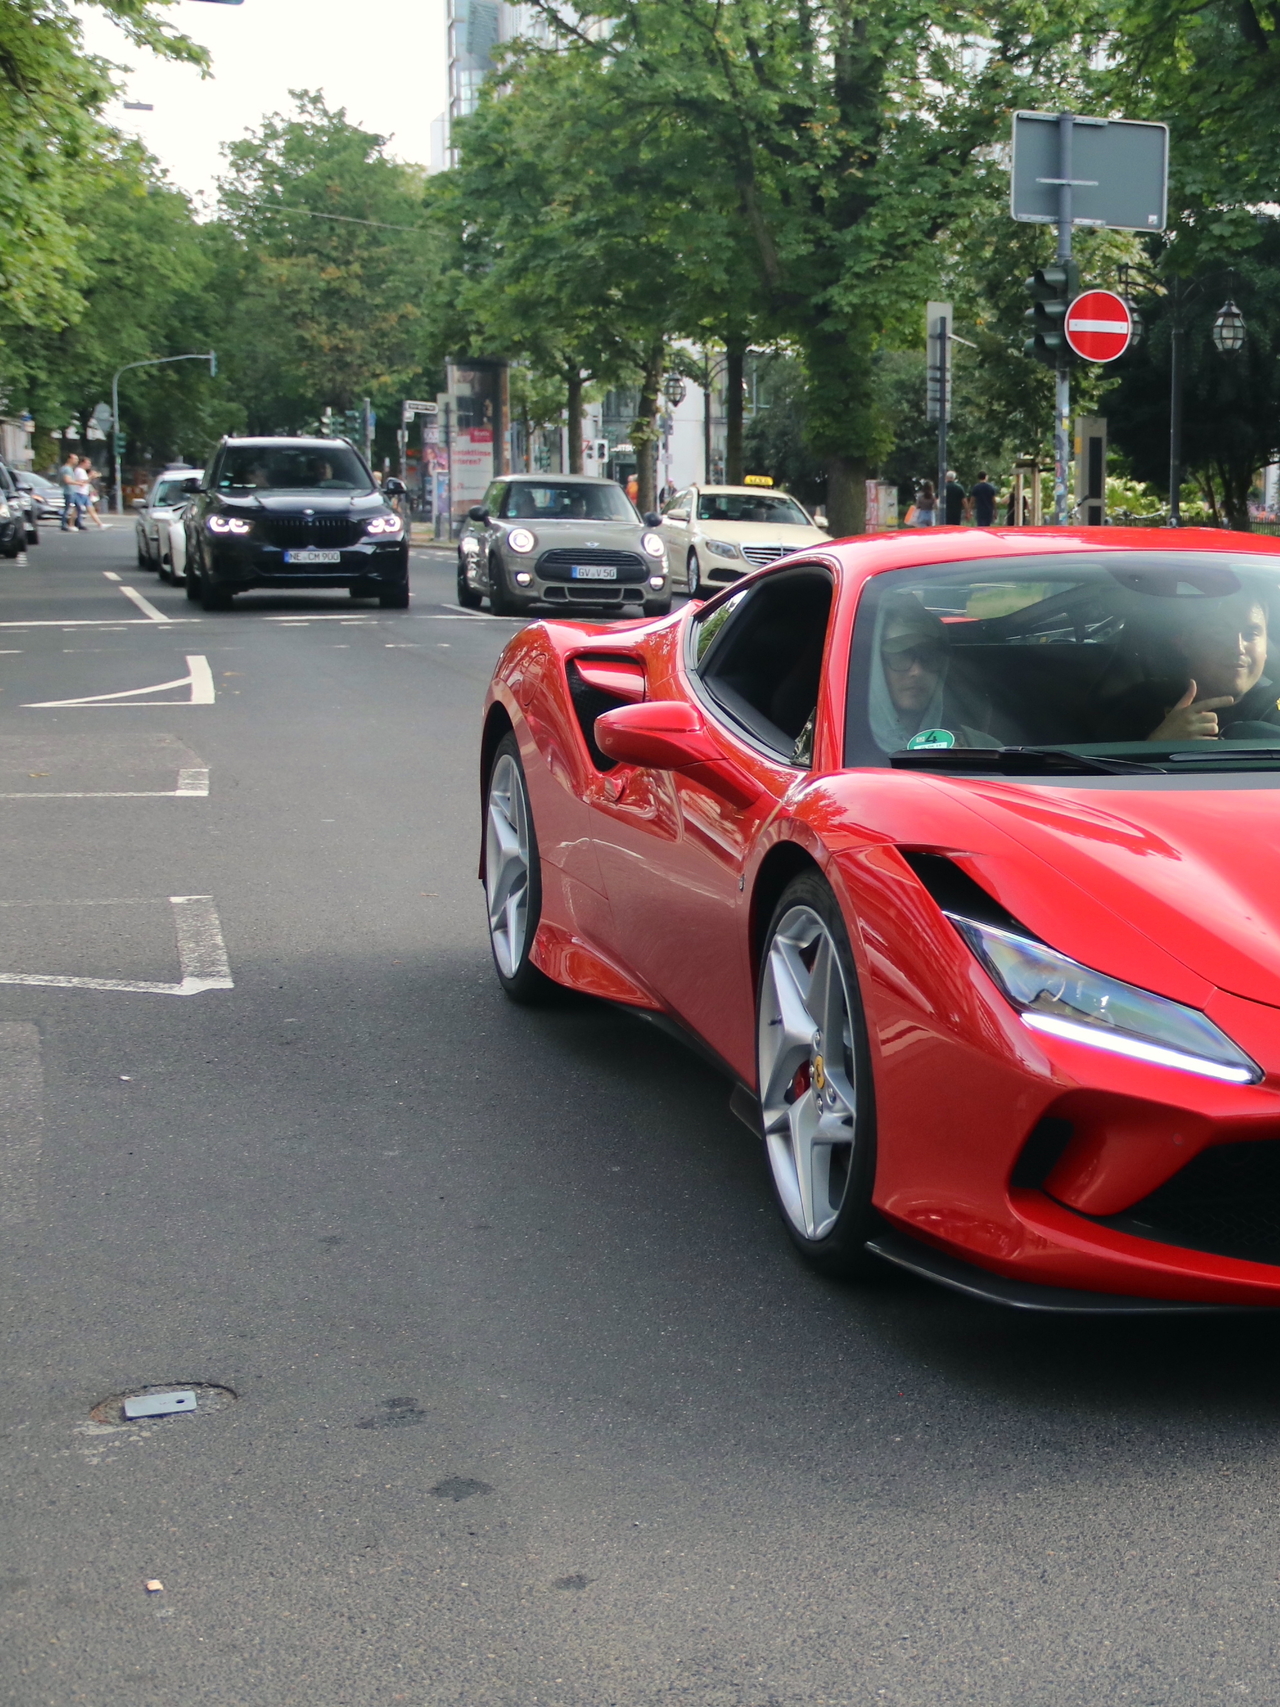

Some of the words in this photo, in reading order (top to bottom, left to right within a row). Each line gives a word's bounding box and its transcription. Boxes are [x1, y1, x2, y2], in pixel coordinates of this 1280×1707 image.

[578, 568, 590, 577] GV
[596, 569, 602, 577] V
[603, 569, 615, 578] 50
[925, 731, 938, 743] 4
